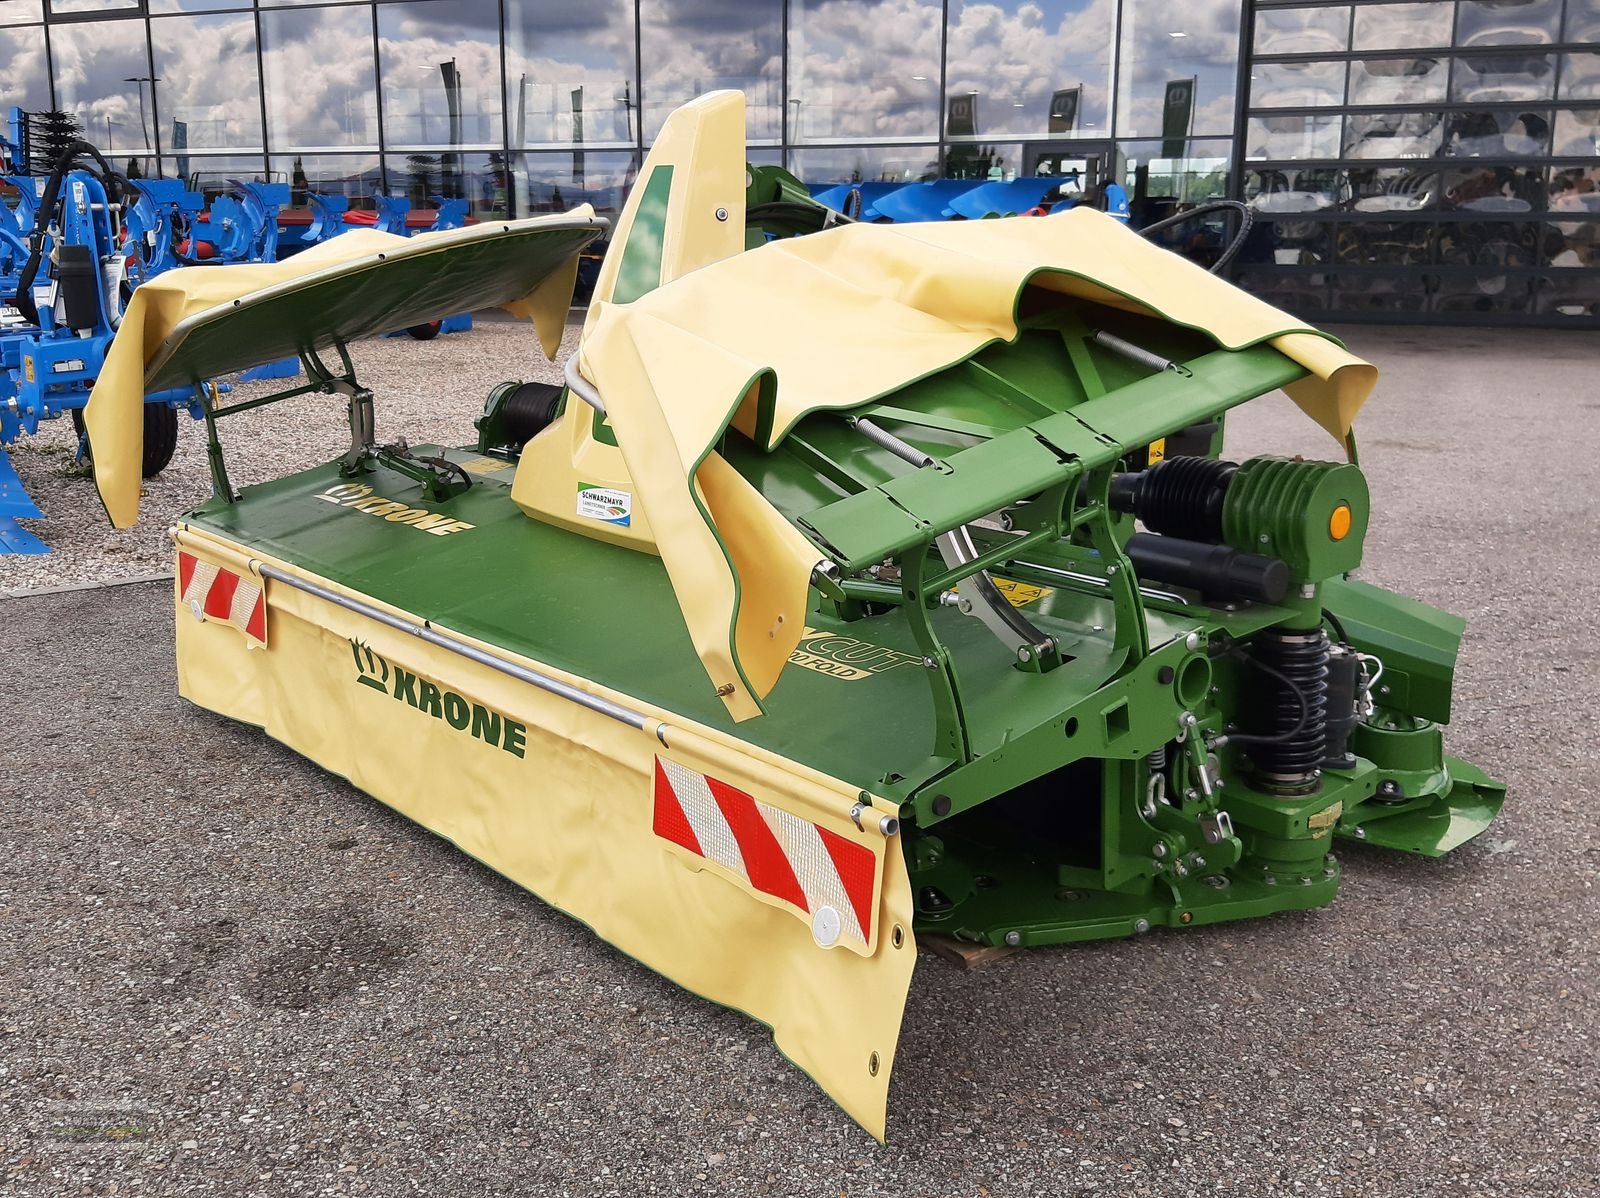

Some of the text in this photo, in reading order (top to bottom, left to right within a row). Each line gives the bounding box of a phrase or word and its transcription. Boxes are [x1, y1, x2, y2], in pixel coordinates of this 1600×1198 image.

[582, 491, 624, 506] SCHWARZMAYR
[341, 496, 477, 536] KRONE
[803, 659, 858, 677] FOLD
[393, 665, 527, 760] KRONE
